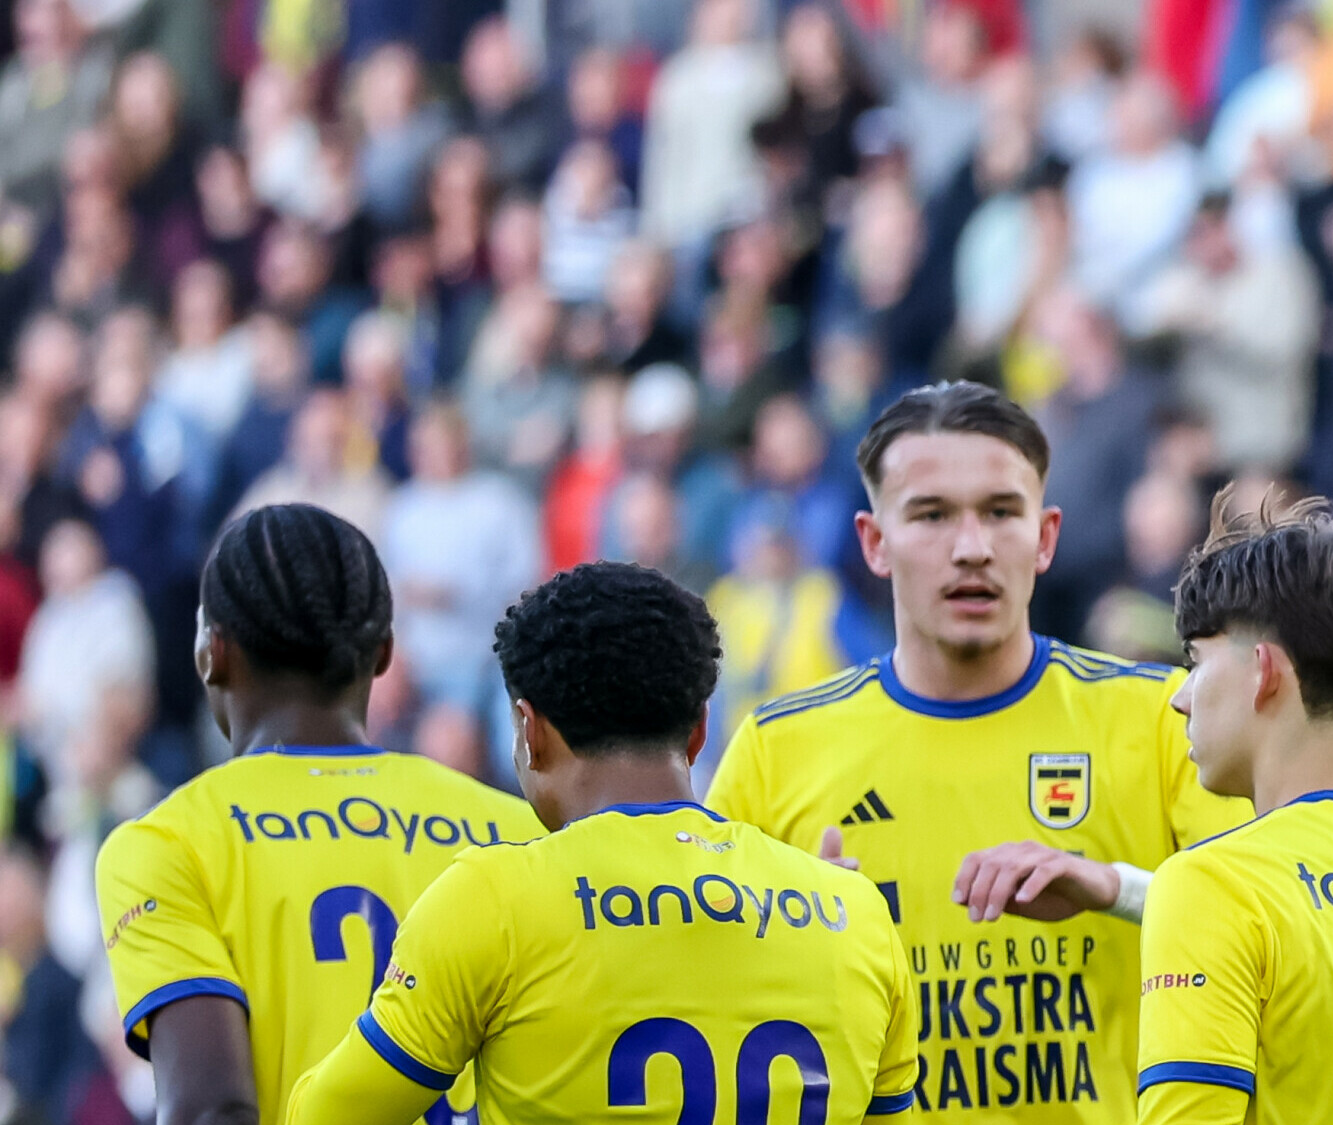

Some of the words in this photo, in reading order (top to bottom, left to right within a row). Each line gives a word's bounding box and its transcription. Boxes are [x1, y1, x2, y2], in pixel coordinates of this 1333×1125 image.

[230, 797, 499, 854] tanQyou
[574, 874, 847, 939] tanQyou
[912, 936, 1095, 974] UWGROEP
[918, 972, 1095, 1042] JKSTRA
[914, 1041, 1098, 1112] RAISMA
